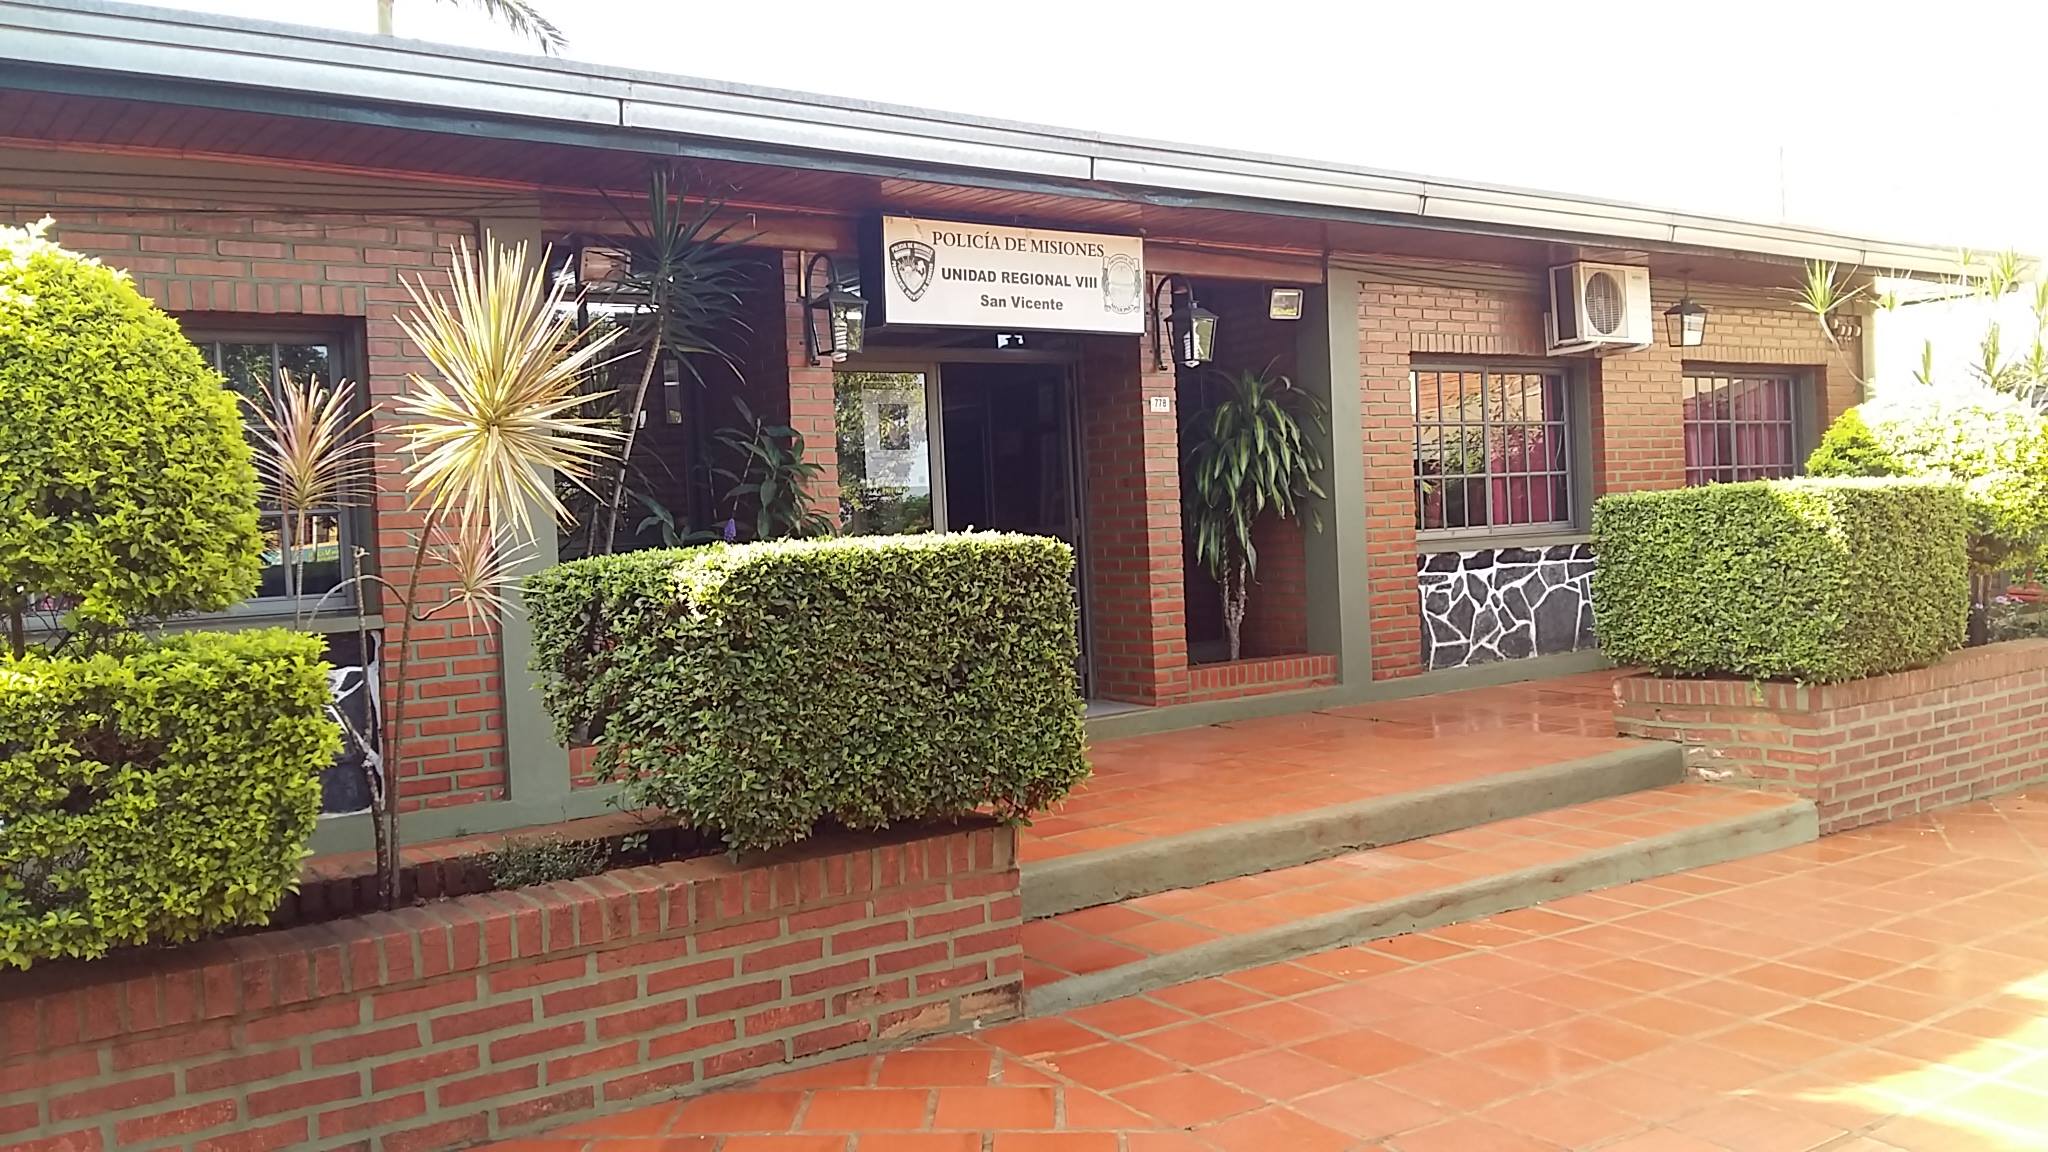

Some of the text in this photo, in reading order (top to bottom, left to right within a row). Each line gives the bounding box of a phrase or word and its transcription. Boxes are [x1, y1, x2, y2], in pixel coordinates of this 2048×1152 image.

[932, 231, 1001, 250] POLICÍA
[1005, 237, 1026, 251] DE
[1030, 239, 1104, 257] MISIONES
[942, 267, 1097, 288] UNIDAD REGIONAL VIII
[980, 294, 1063, 310] San Vicente
[1154, 398, 1167, 408] 778
